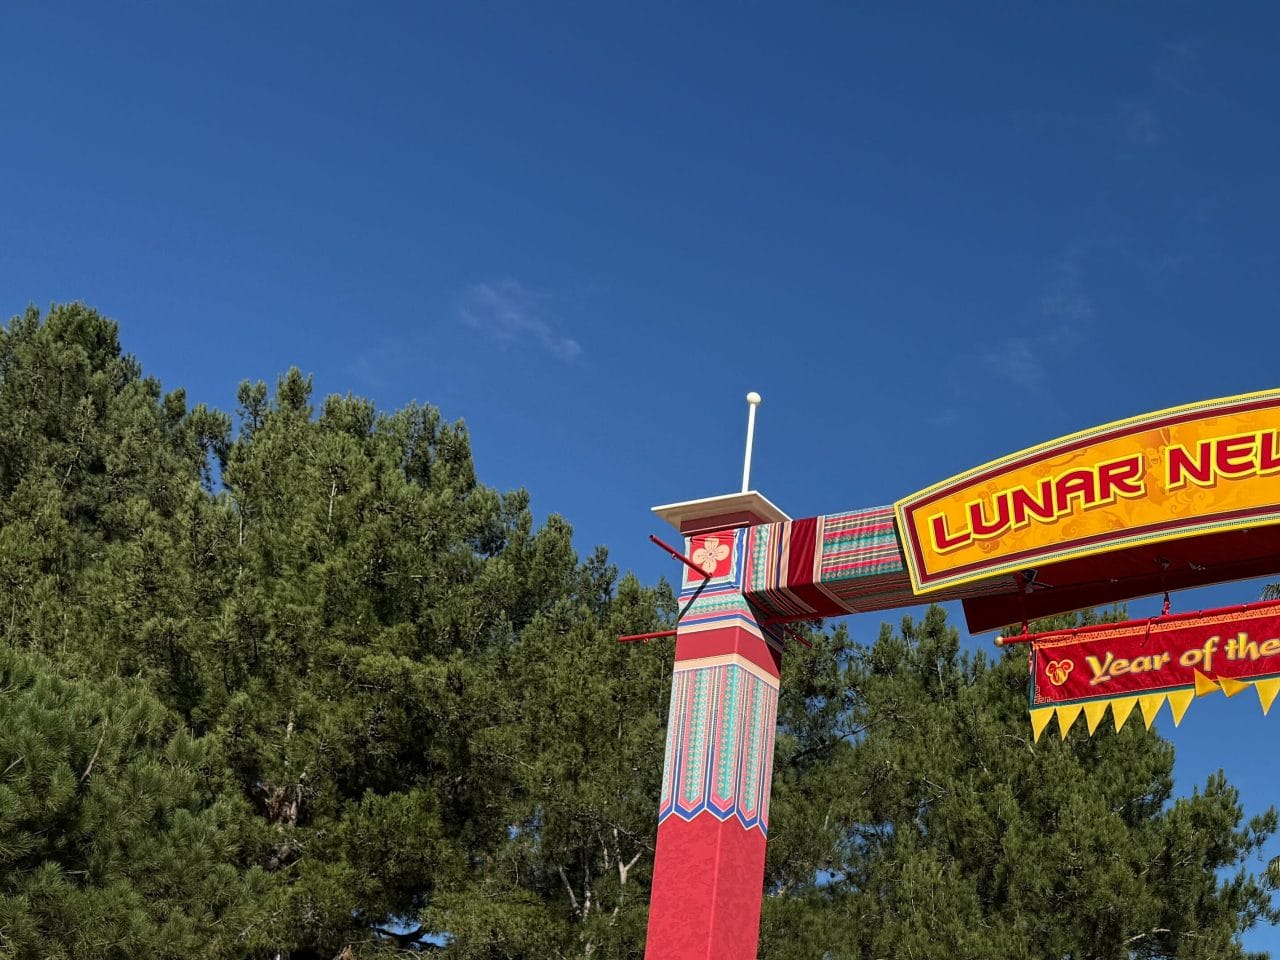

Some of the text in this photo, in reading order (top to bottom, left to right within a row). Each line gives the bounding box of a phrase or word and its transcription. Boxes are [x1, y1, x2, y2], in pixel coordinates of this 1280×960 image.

[929, 453, 1145, 552] LUNAR
[1085, 650, 1171, 686] Year
[1179, 635, 1220, 672] of
